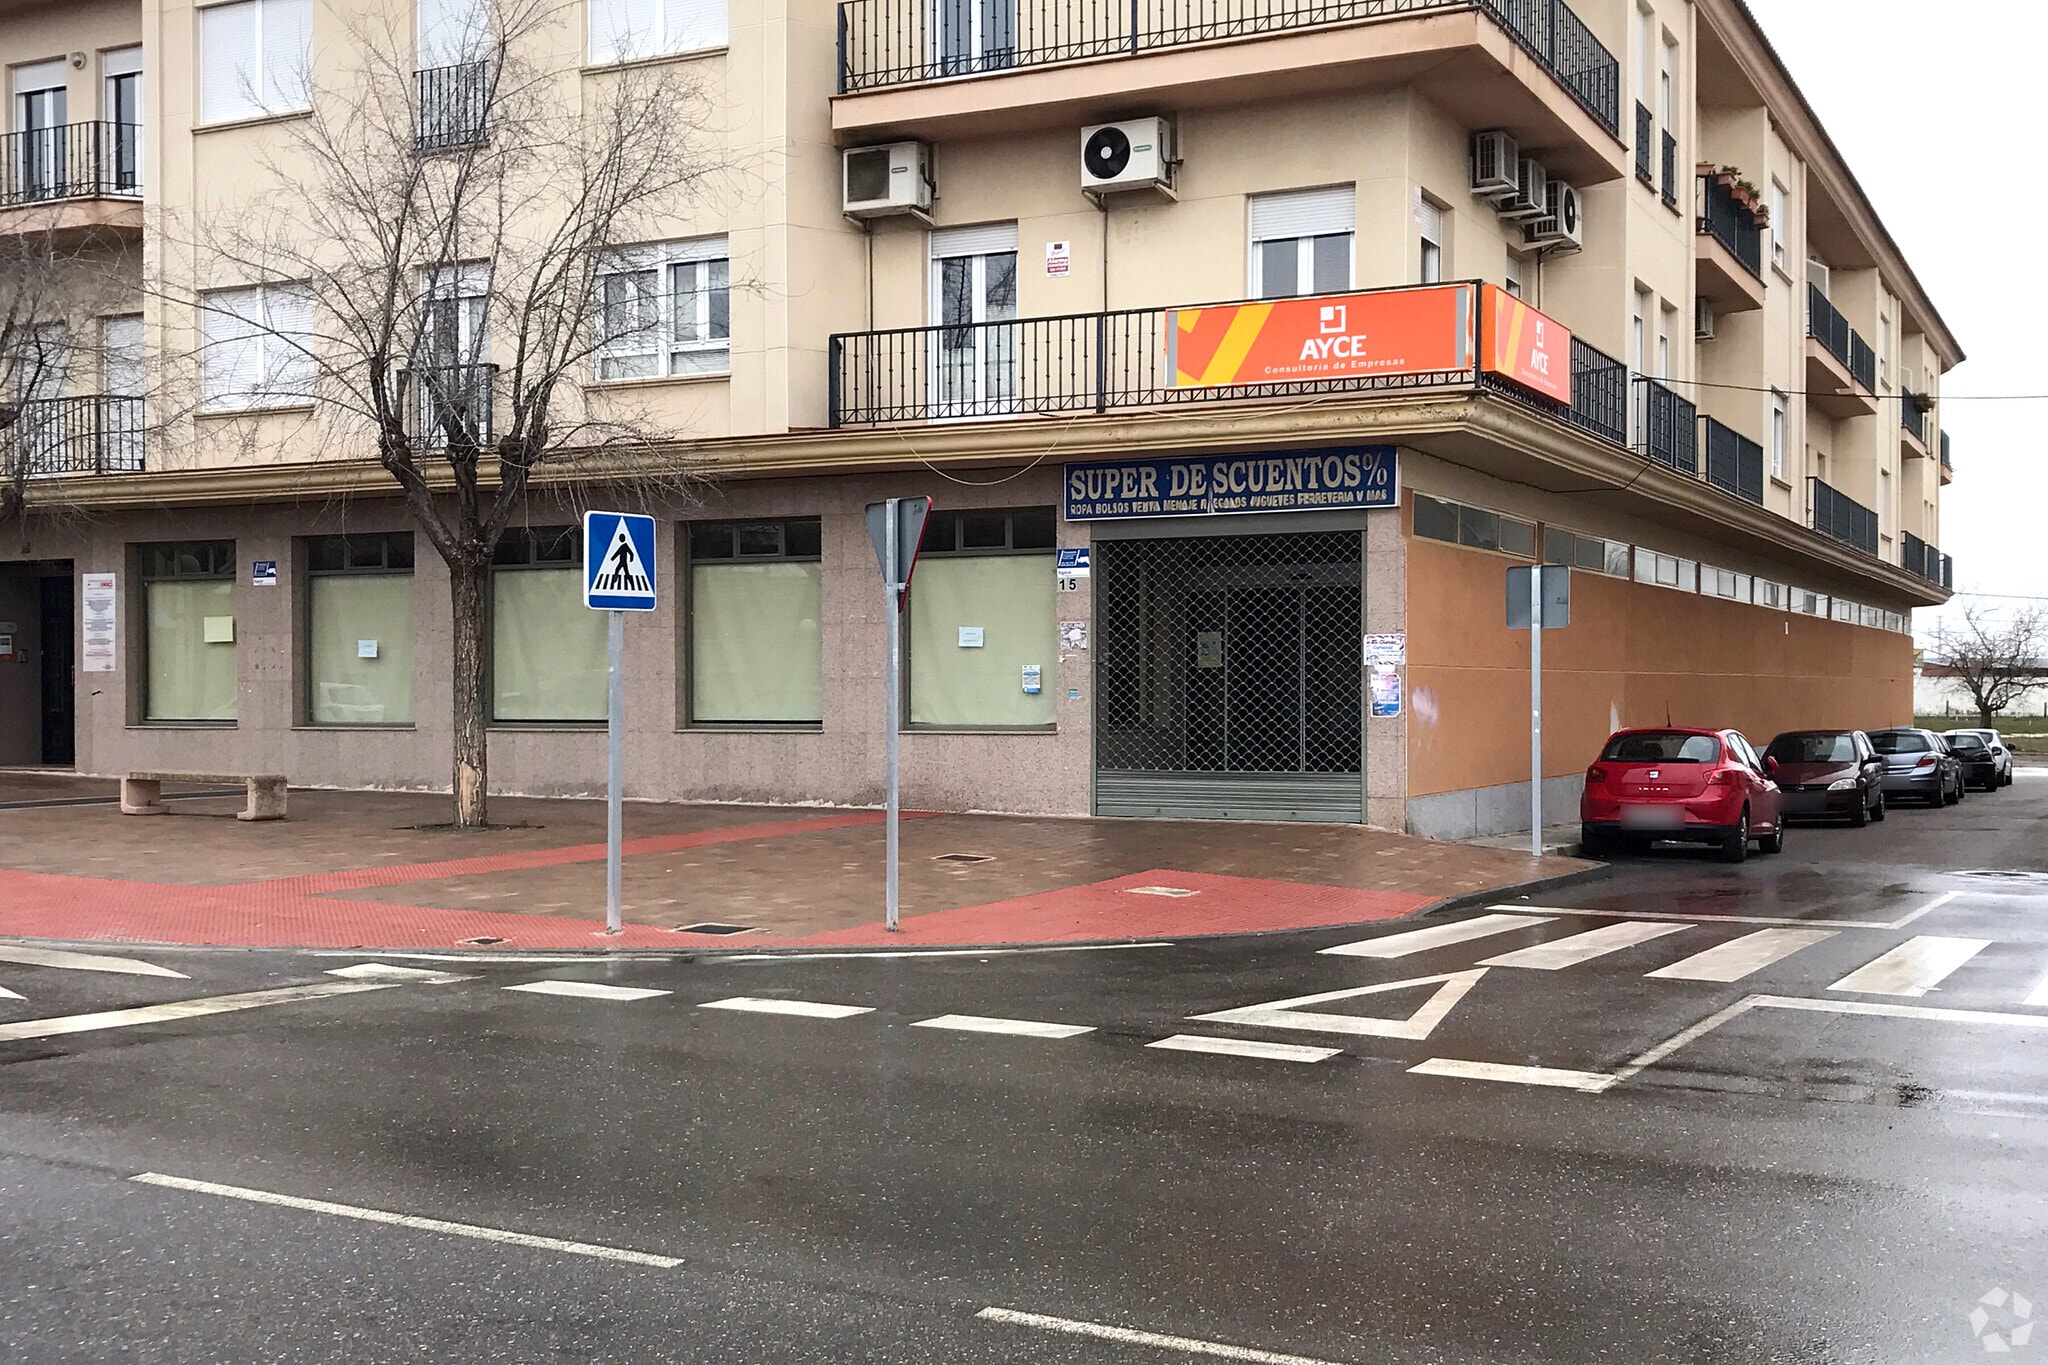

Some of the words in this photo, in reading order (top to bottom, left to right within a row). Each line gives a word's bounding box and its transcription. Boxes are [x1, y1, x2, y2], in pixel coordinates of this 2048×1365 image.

[1299, 335, 1367, 361] AYCE
[1333, 361, 1346, 370] de
[1350, 358, 1405, 369] Empresas
[1531, 348, 1549, 375] AYCE
[1070, 466, 1159, 500] SUPER
[1070, 503, 1093, 515] ROPA
[1095, 502, 1129, 514] BOLSOS
[1059, 579, 1076, 590] 15
